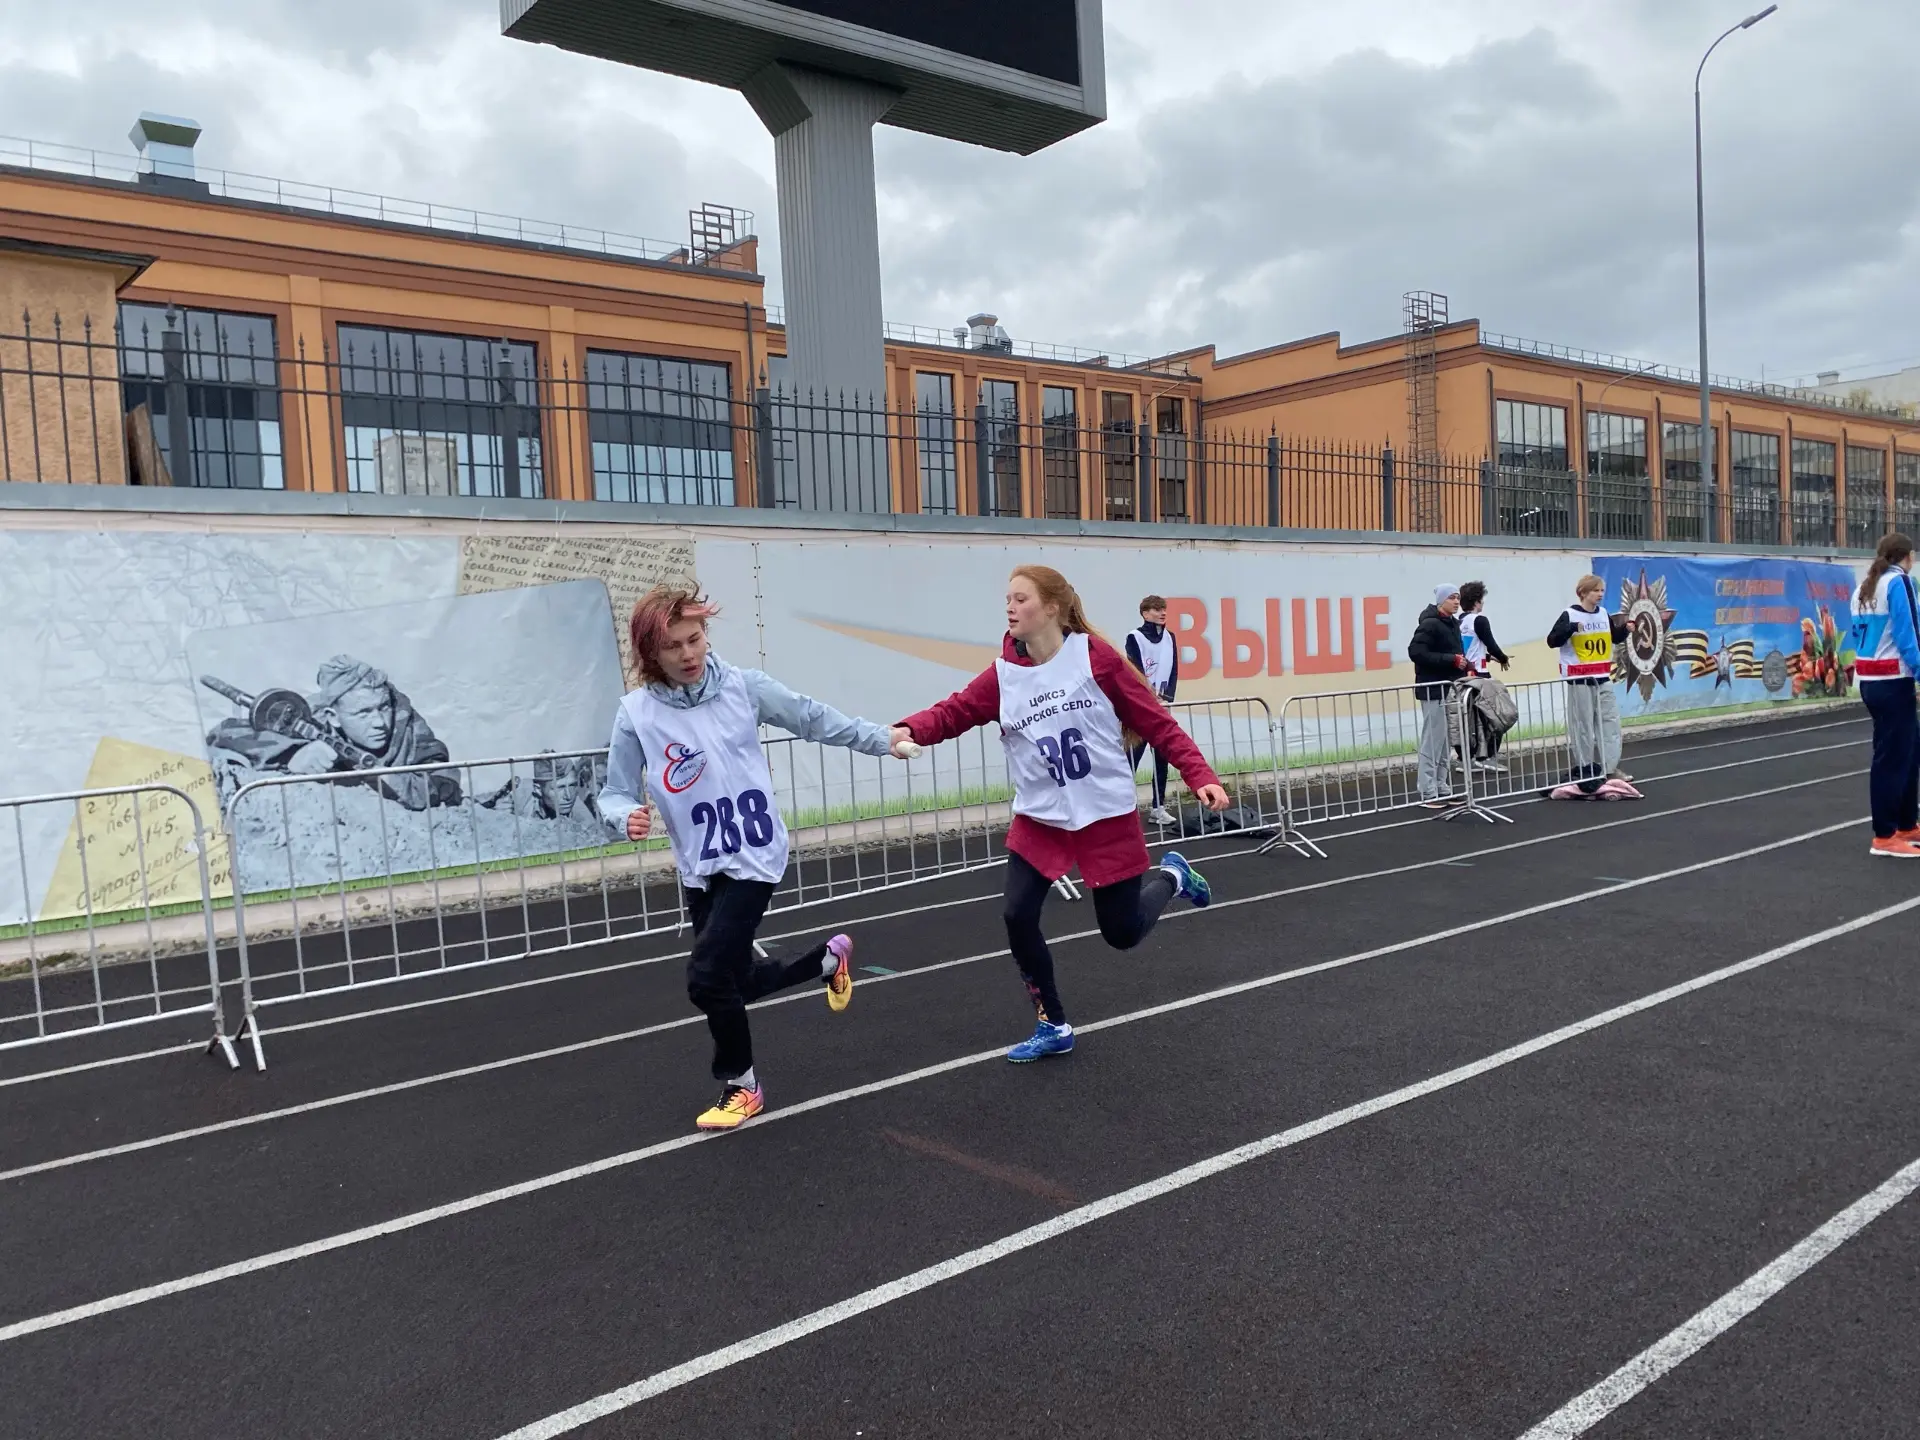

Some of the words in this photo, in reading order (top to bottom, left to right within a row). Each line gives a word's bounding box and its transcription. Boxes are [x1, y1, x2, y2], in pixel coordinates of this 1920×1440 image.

[1164, 596, 1392, 681] ВЫШЕ
[1584, 638, 1607, 656] 90
[1035, 728, 1092, 788] 36
[691, 789, 774, 861] 288
